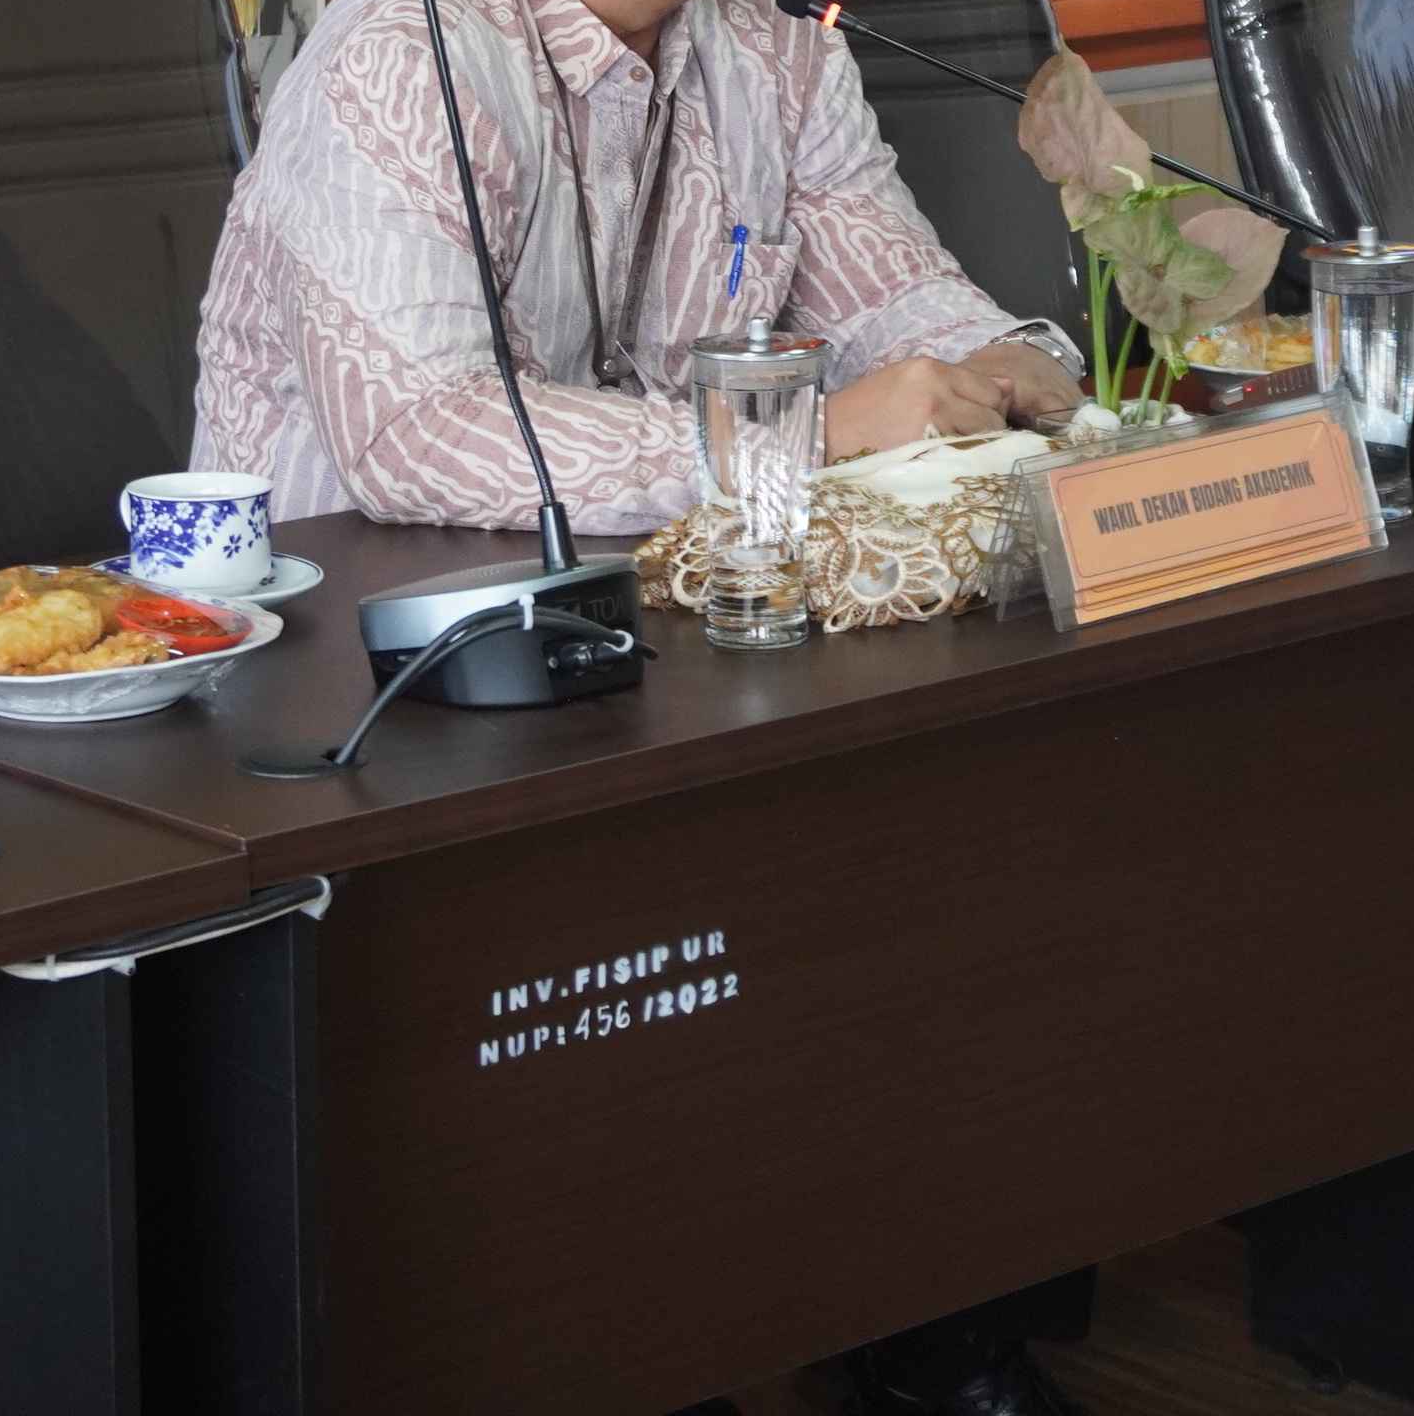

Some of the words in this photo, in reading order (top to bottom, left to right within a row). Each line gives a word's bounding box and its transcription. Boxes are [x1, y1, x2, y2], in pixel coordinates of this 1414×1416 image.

[1093, 501, 1142, 535] WAKIL
[1141, 489, 1189, 524] DEKAN
[1190, 477, 1243, 513] BIDANG
[1243, 460, 1316, 500] AKADEMIK
[682, 930, 726, 962] UR
